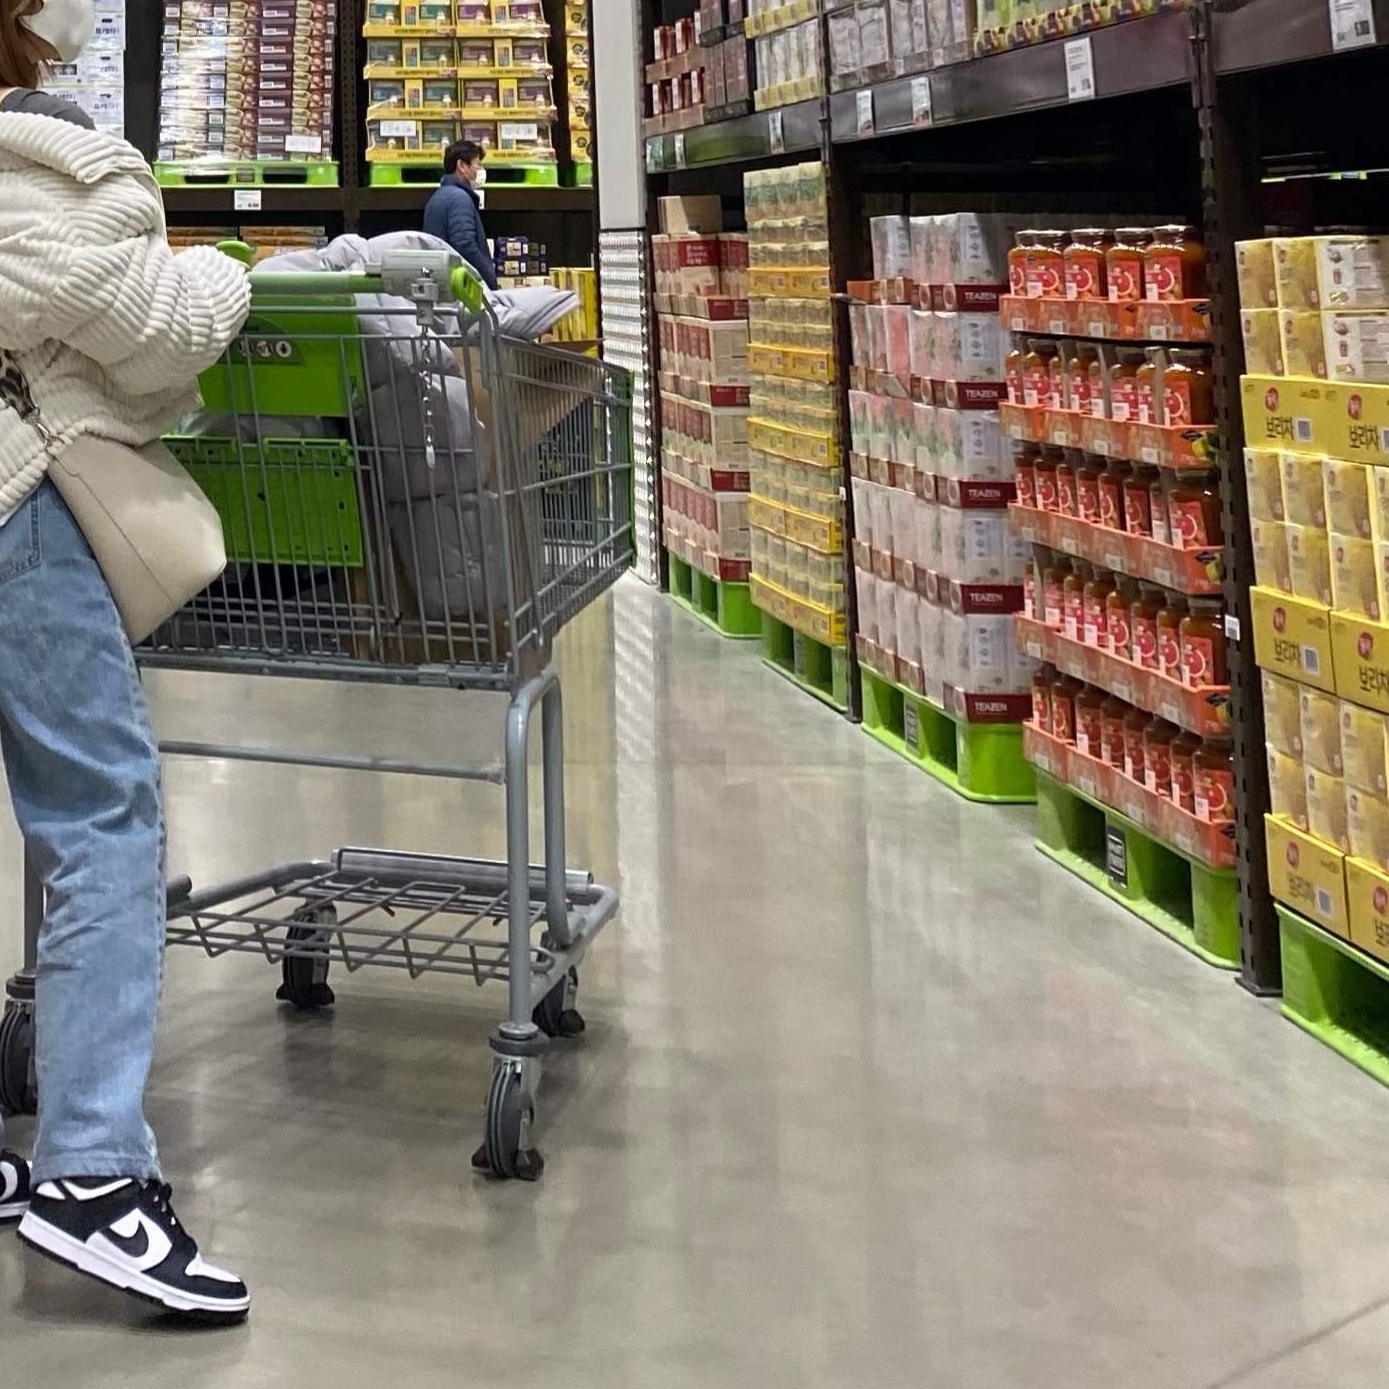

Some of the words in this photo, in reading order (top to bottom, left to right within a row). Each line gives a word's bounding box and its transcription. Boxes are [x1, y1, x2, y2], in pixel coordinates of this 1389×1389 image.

[964, 292, 997, 301] TEAZEN
[965, 390, 998, 399] TEAZEN
[1266, 416, 1295, 440] 보리차
[1349, 425, 1380, 452] 보리차
[968, 489, 1002, 499] TEAZEN
[969, 593, 1003, 603] TEAZEN
[1274, 638, 1301, 669] 보리차
[974, 702, 1007, 712] TEAZEN
